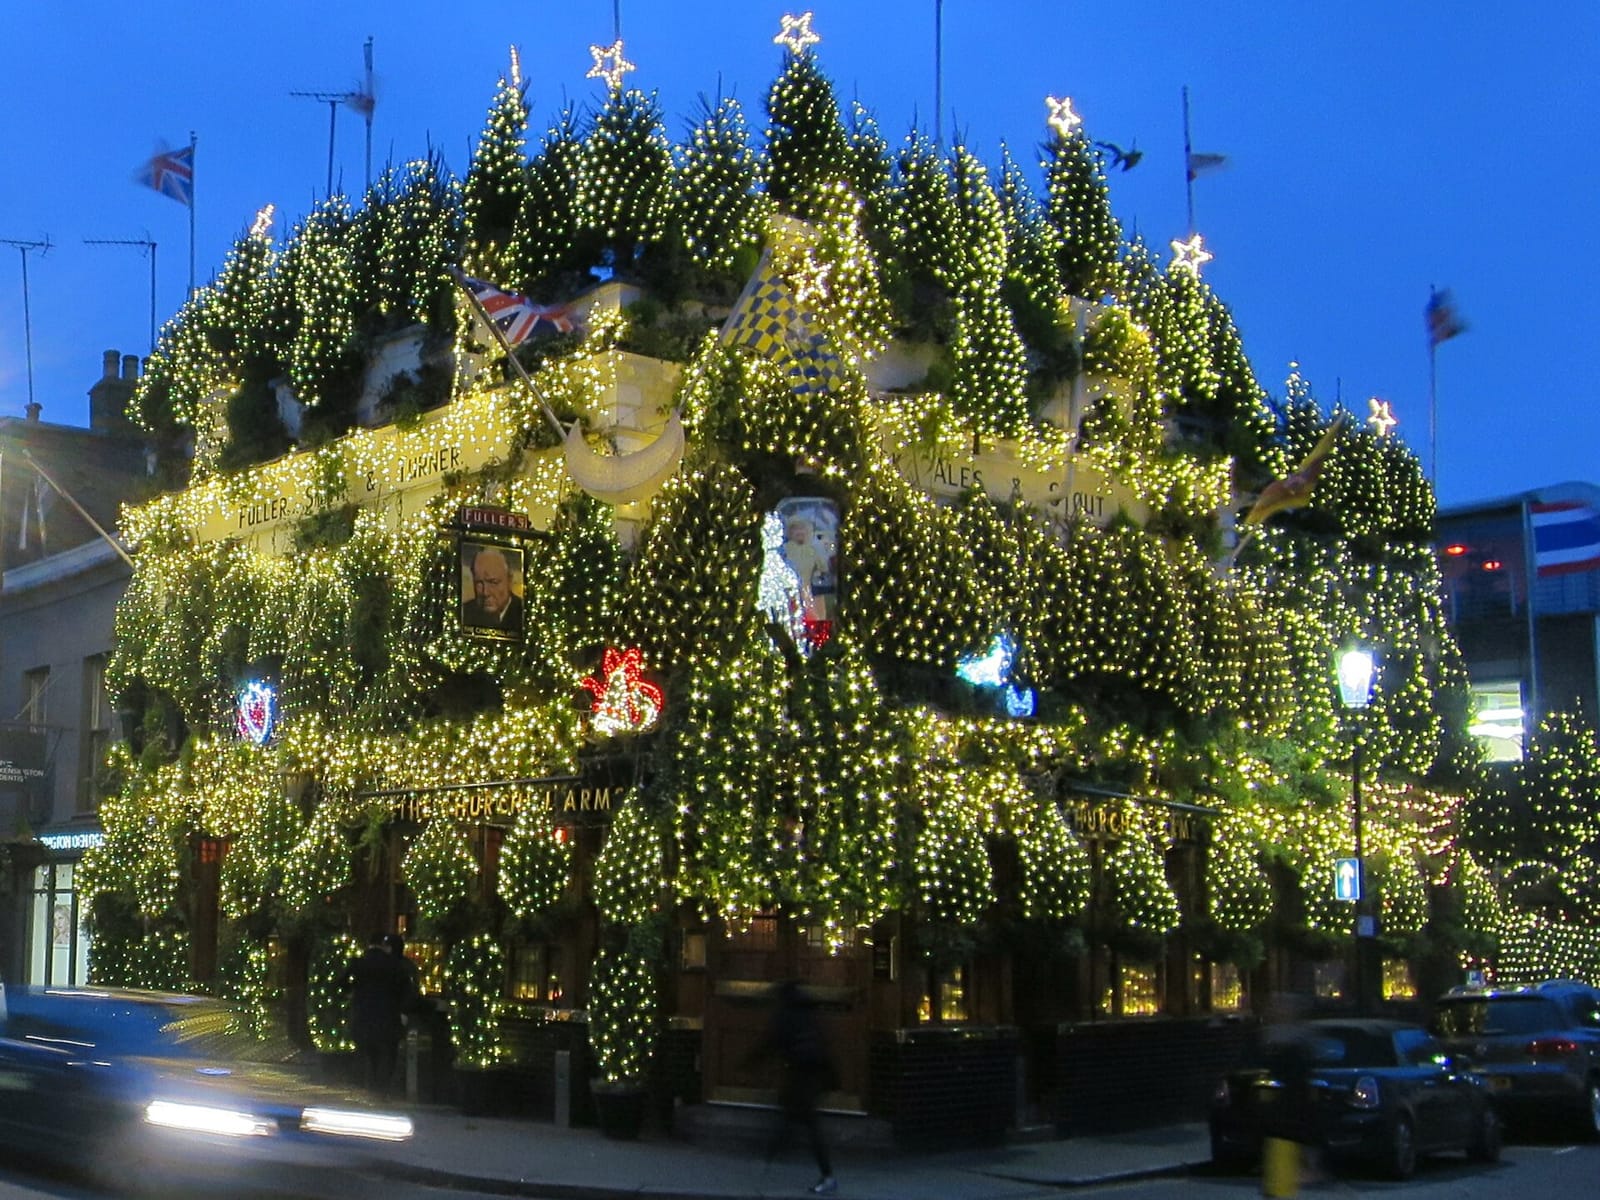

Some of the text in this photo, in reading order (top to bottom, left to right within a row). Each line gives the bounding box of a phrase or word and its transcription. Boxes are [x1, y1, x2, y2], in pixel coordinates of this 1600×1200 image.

[366, 471, 375, 491] &
[934, 458, 982, 488] ALES
[563, 787, 624, 812] ARM
